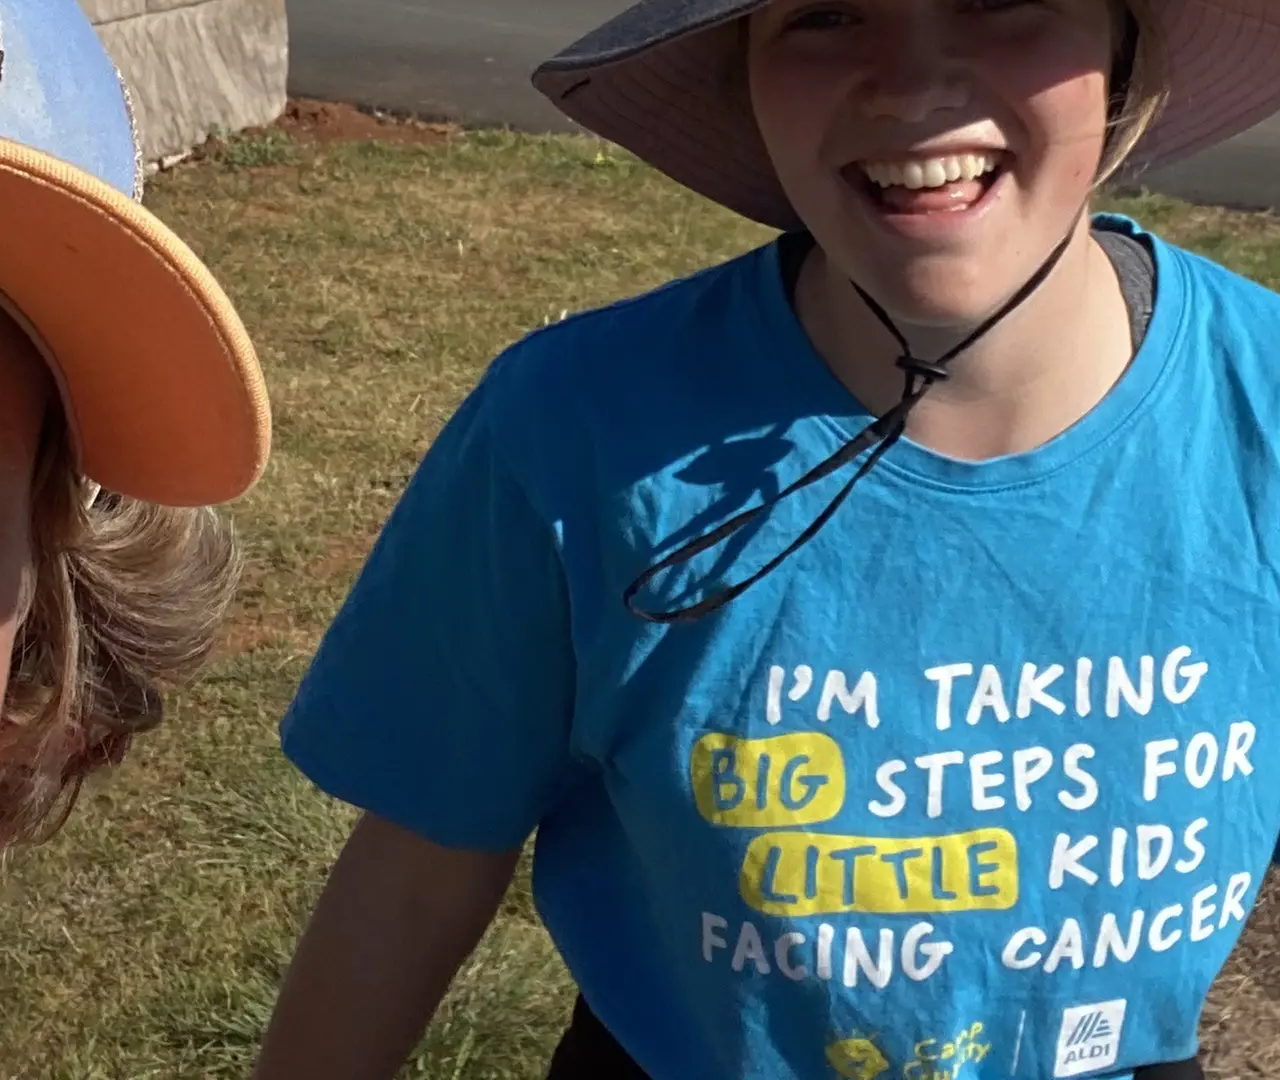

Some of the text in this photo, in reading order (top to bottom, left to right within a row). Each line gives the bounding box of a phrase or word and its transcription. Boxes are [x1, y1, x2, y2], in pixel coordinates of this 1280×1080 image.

[765, 645, 1209, 731] I'M TAKING
[711, 720, 1257, 819] BIG STEPS FOR
[761, 816, 1209, 906] LITTLE KIDS
[700, 871, 1253, 989] FACING CANCER
[1063, 1043, 1110, 1065] ALDI
